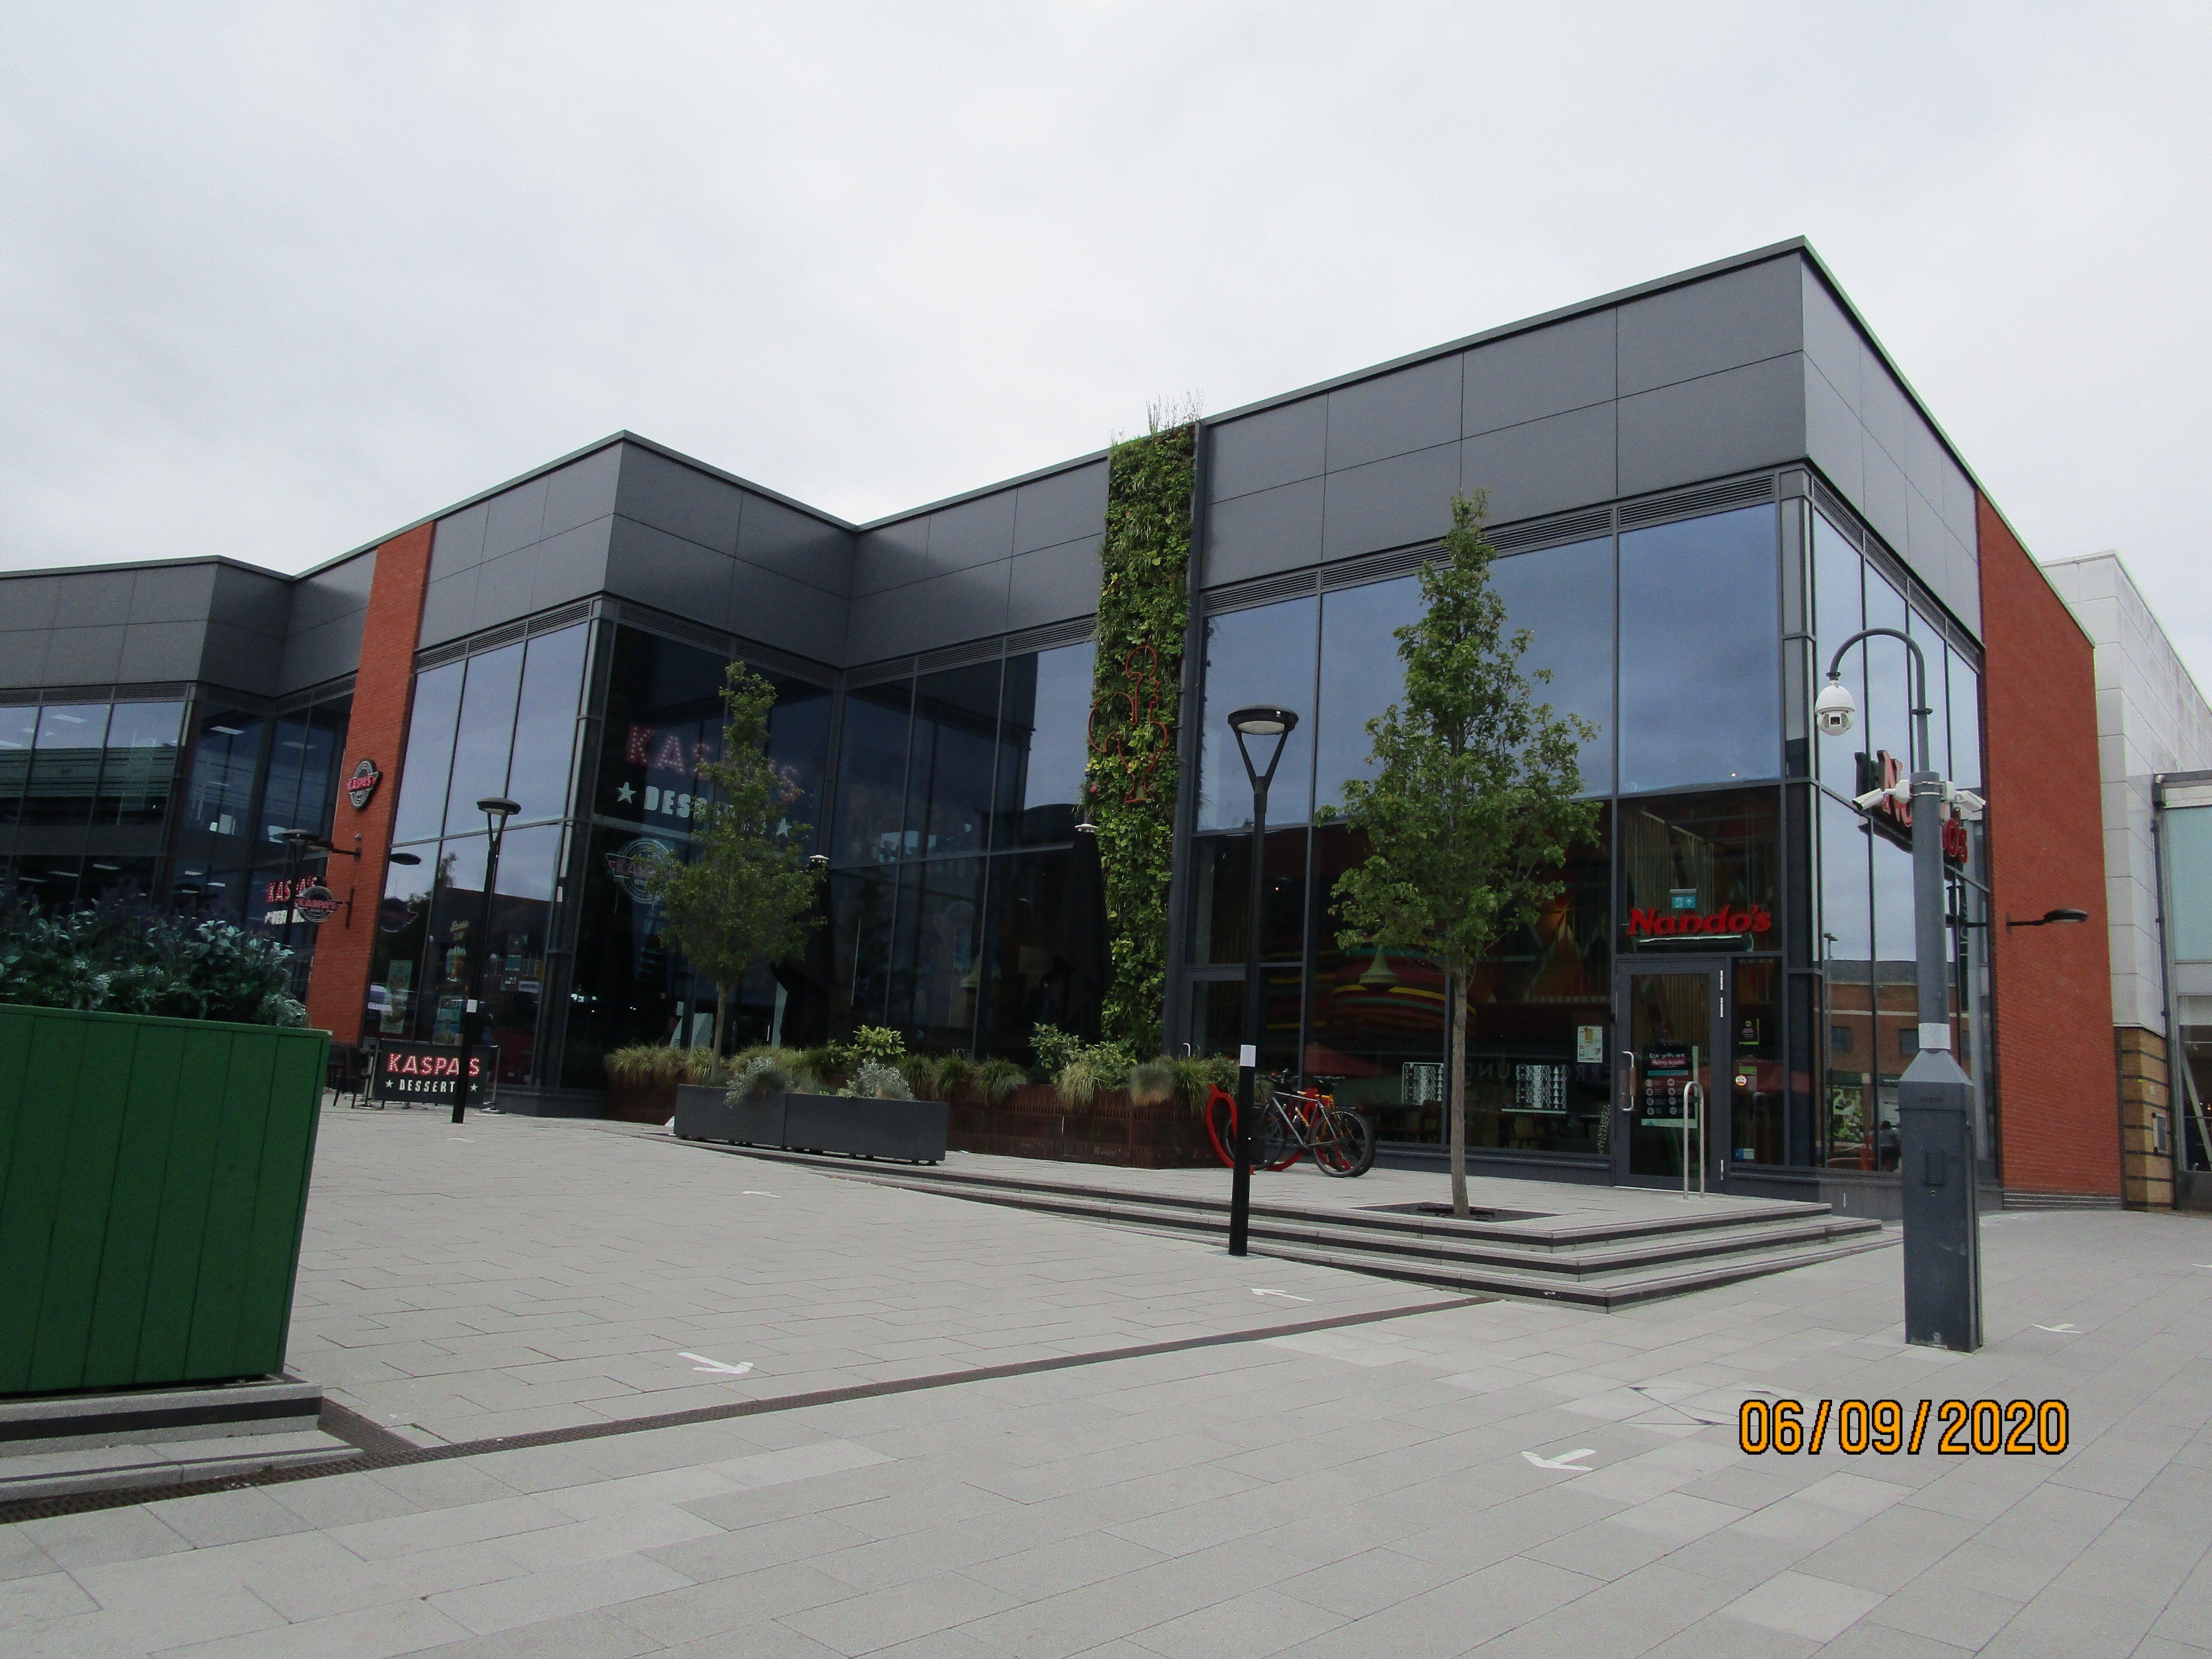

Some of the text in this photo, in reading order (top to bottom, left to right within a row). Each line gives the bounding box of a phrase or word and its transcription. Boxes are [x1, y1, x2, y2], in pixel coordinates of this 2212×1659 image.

[1627, 904, 1771, 935] Nando's
[387, 1053, 480, 1077] KASPAS
[399, 1079, 456, 1093] DESSERT
